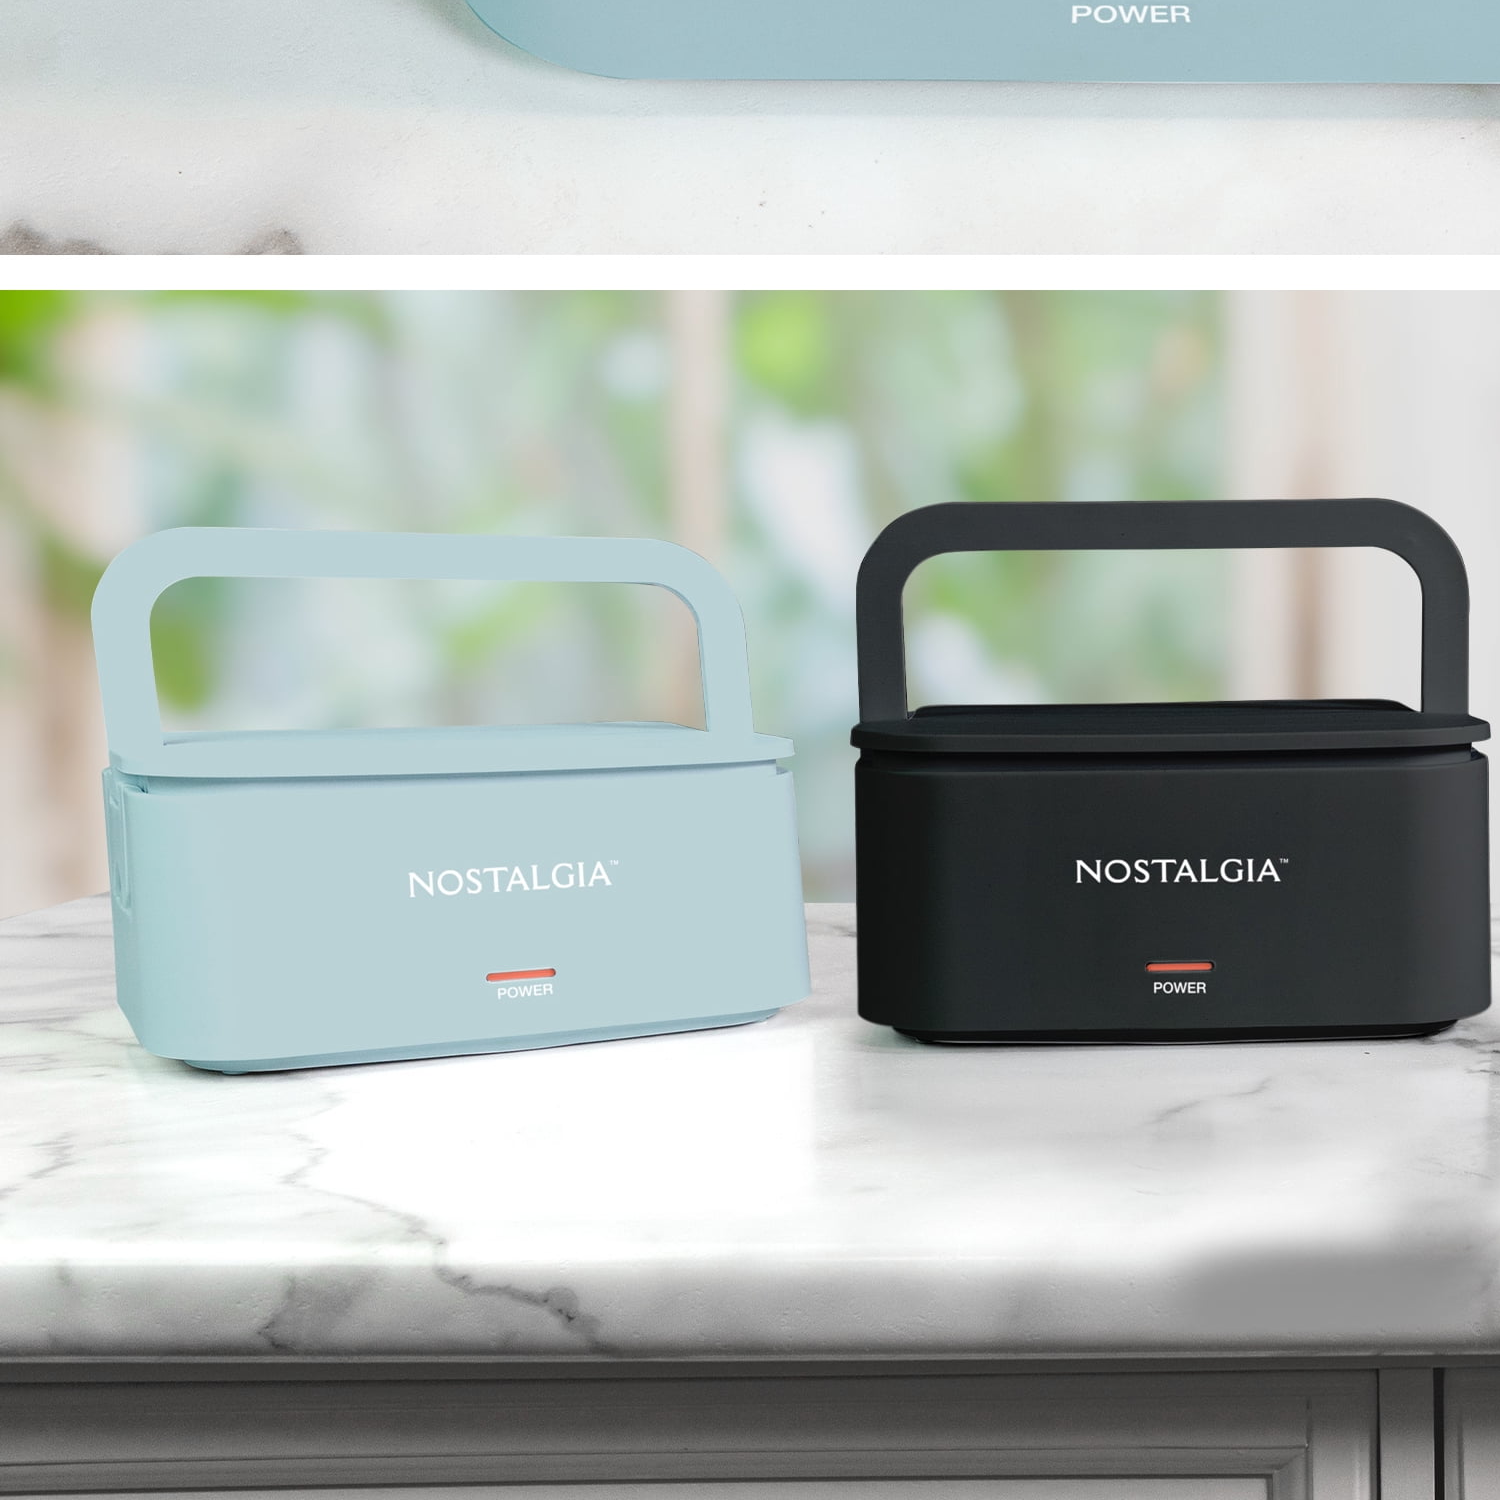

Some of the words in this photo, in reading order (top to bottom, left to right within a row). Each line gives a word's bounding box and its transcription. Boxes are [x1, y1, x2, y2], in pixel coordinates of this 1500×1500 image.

[1071, 4, 1191, 24] POWER
[497, 983, 554, 999] POWER
[1153, 981, 1207, 994] POWER
